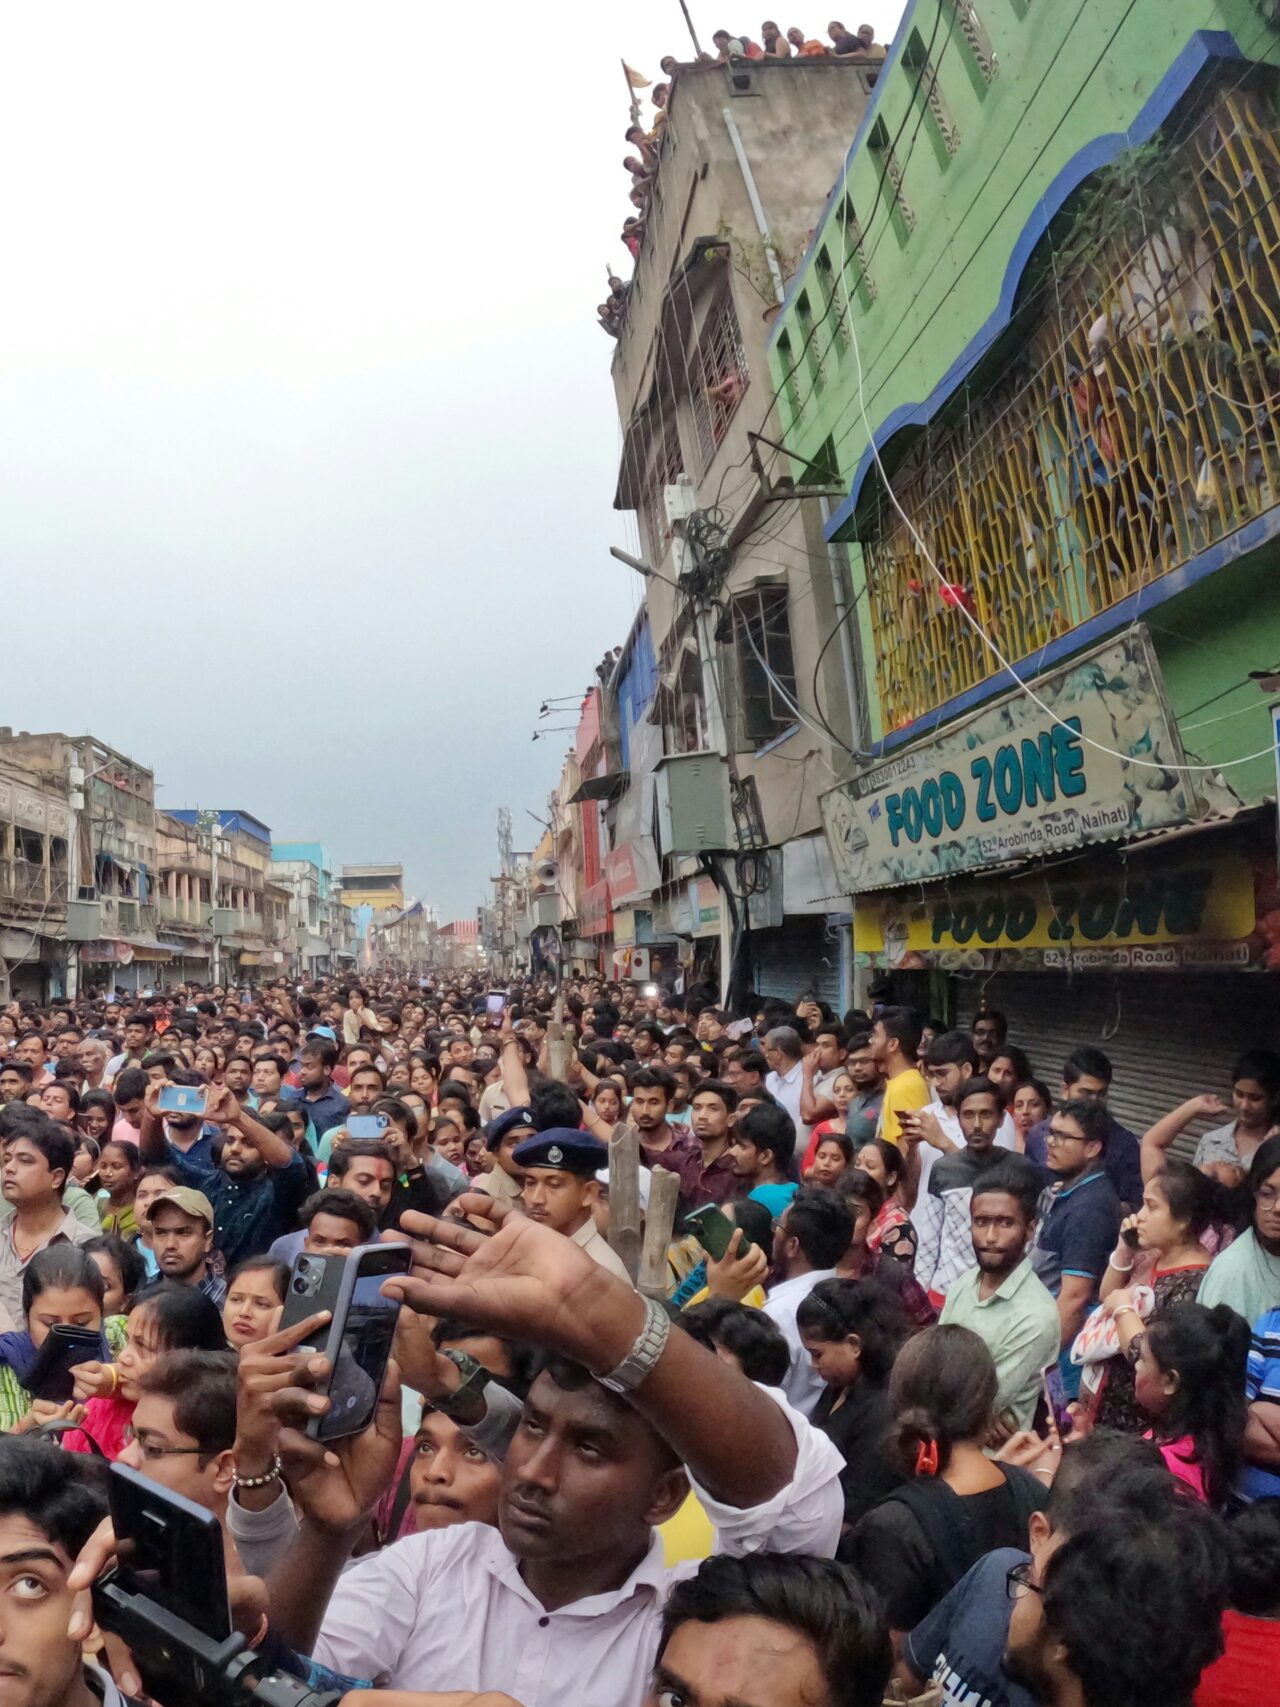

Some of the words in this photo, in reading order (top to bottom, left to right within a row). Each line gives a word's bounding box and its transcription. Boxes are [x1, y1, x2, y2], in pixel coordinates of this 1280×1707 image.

[885, 771, 966, 848] FOOD
[970, 716, 1086, 823] ZONE
[998, 826, 1043, 848] Arobinda
[1081, 804, 1128, 831] Naihati
[931, 893, 1038, 944] FOOD
